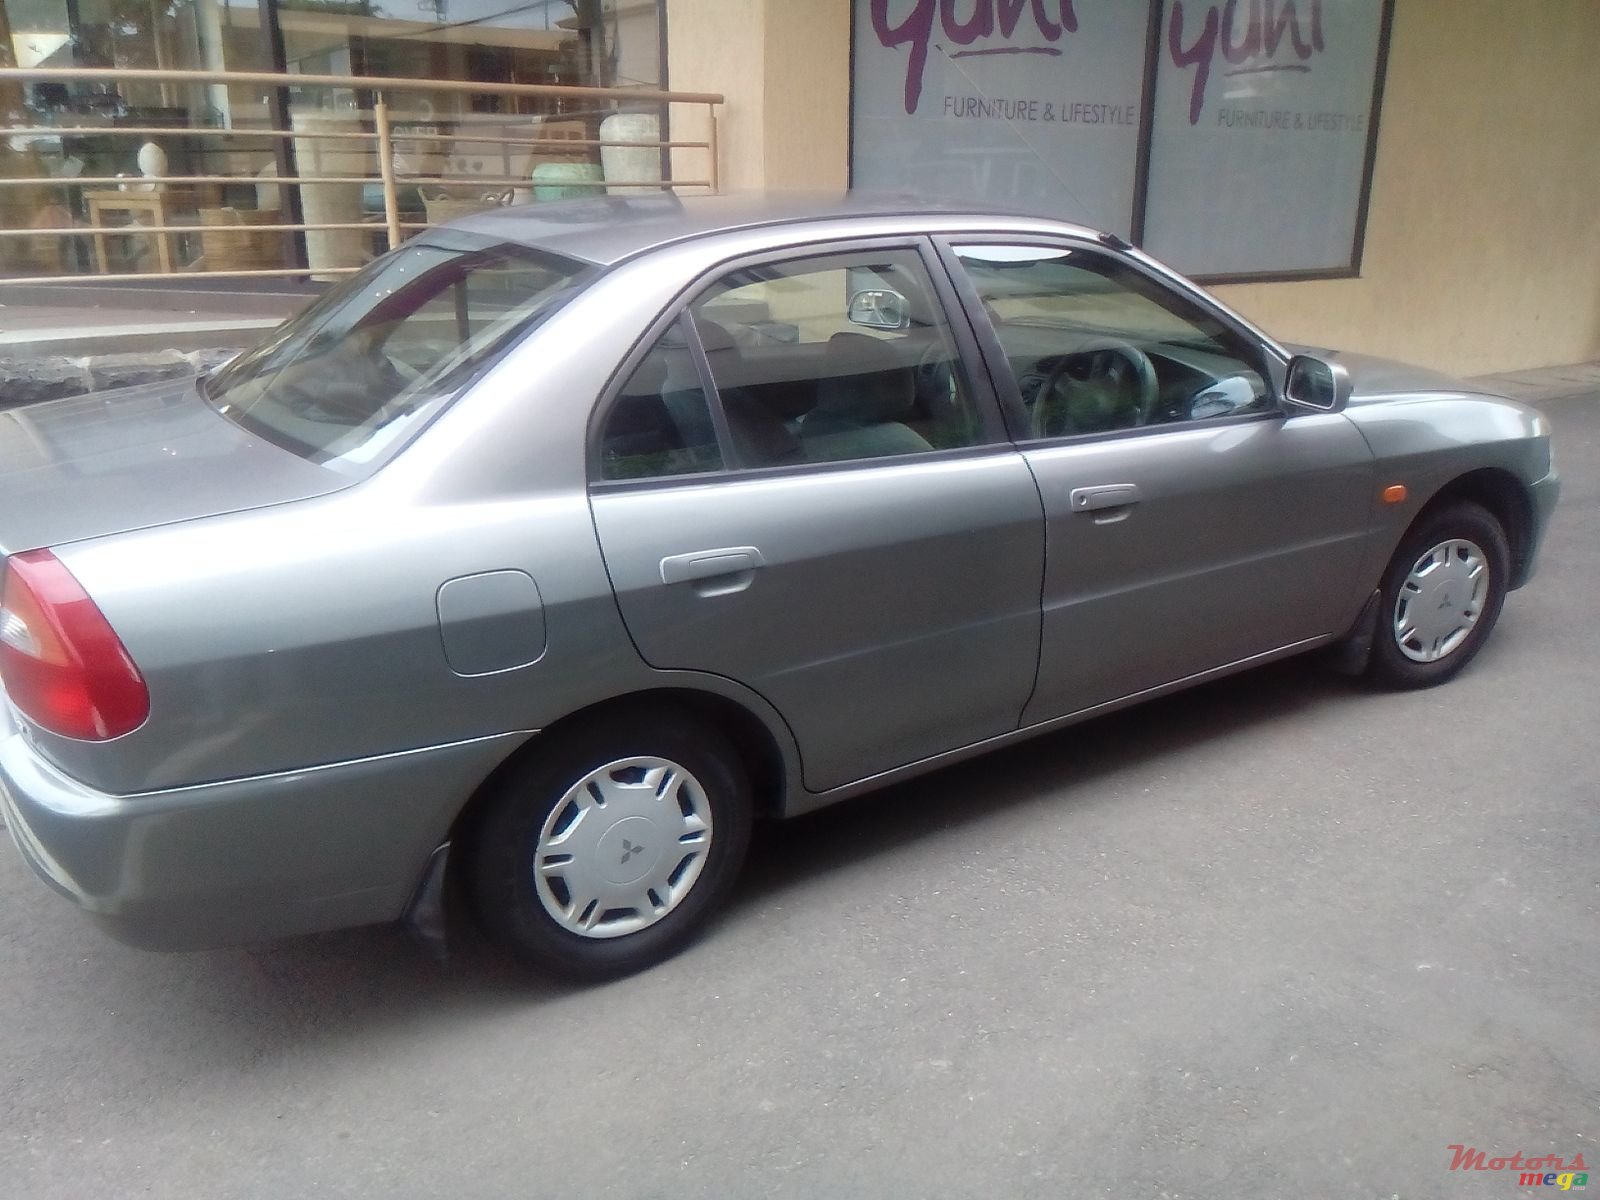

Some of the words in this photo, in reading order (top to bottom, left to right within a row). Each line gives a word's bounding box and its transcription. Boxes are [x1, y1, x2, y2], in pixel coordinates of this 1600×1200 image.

[943, 96, 1038, 121] FURNITURE
[1043, 105, 1055, 120] &
[1061, 103, 1136, 125] LIFESTYLE
[1217, 108, 1292, 130] FURNITURE
[1294, 112, 1305, 130] &
[1308, 112, 1365, 132] LIFESTYLE
